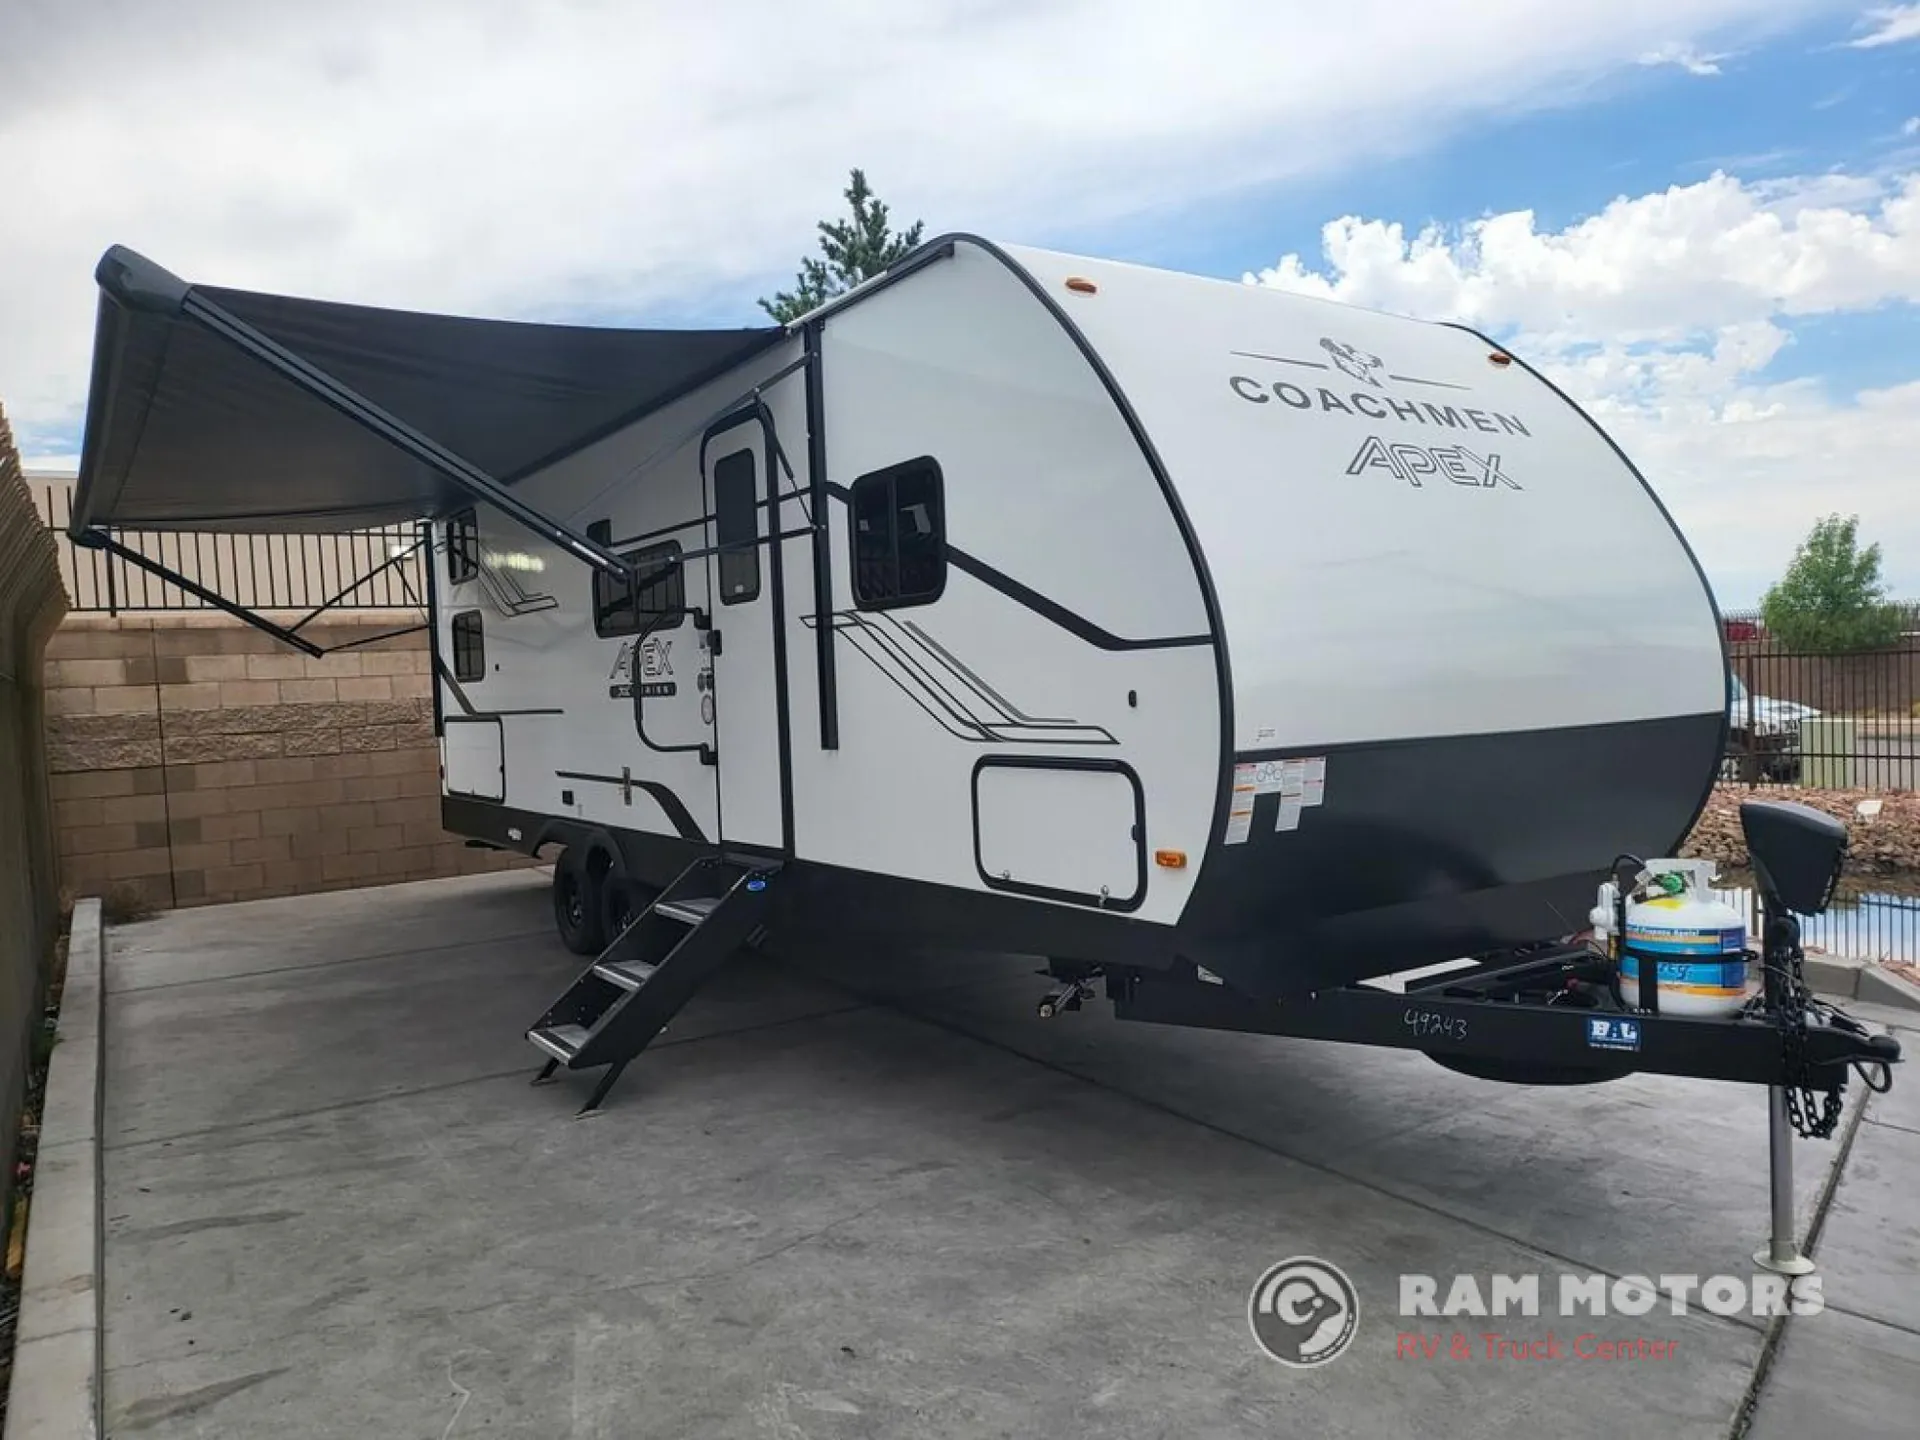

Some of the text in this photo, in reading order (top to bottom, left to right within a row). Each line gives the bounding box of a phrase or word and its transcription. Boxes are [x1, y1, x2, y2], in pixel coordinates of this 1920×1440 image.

[1229, 375, 1532, 438] COACHMEN
[1345, 435, 1523, 491] APEX
[609, 637, 674, 679] AEX
[1404, 1008, 1467, 1040] 49243
